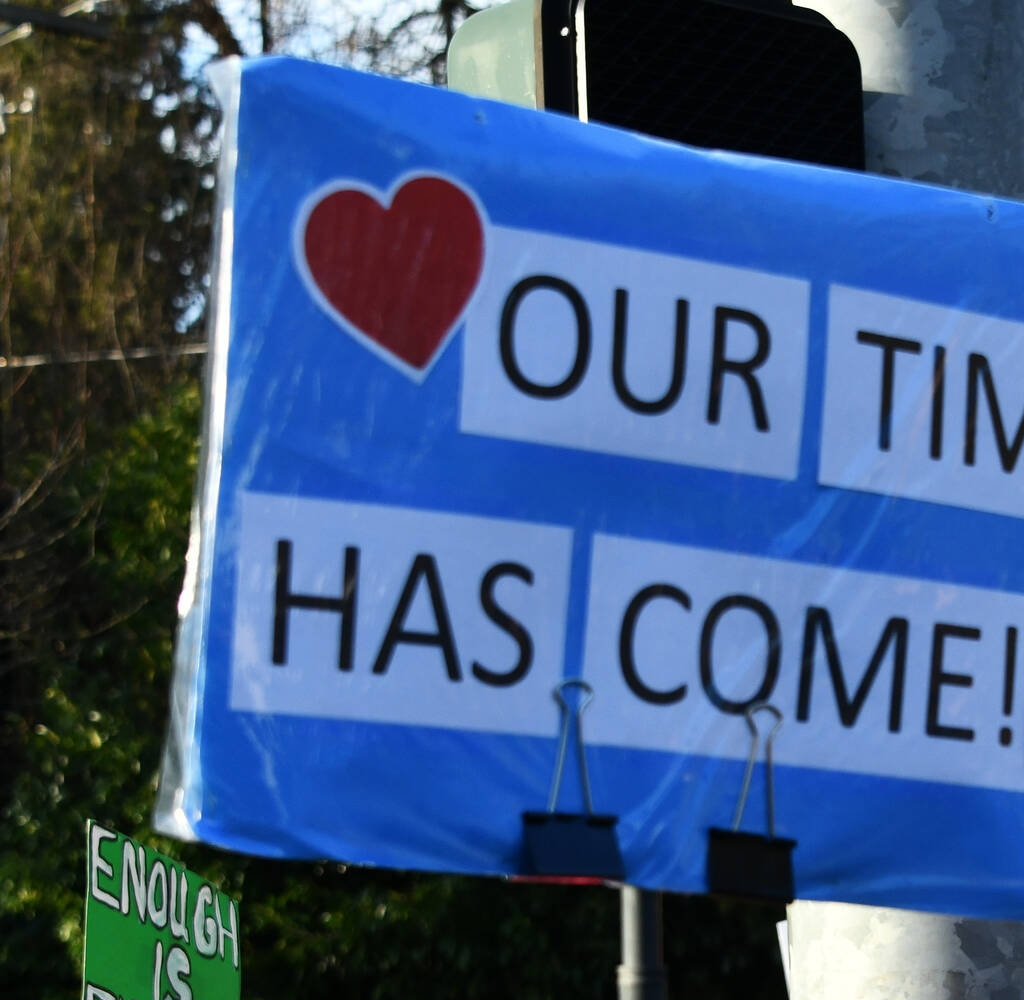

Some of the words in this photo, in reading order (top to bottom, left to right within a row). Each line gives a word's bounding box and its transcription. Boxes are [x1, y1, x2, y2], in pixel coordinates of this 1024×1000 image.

[497, 273, 772, 433] OUR
[270, 538, 535, 687] HAS
[617, 582, 1018, 746] COME!
[90, 824, 239, 969] ENOUGH
